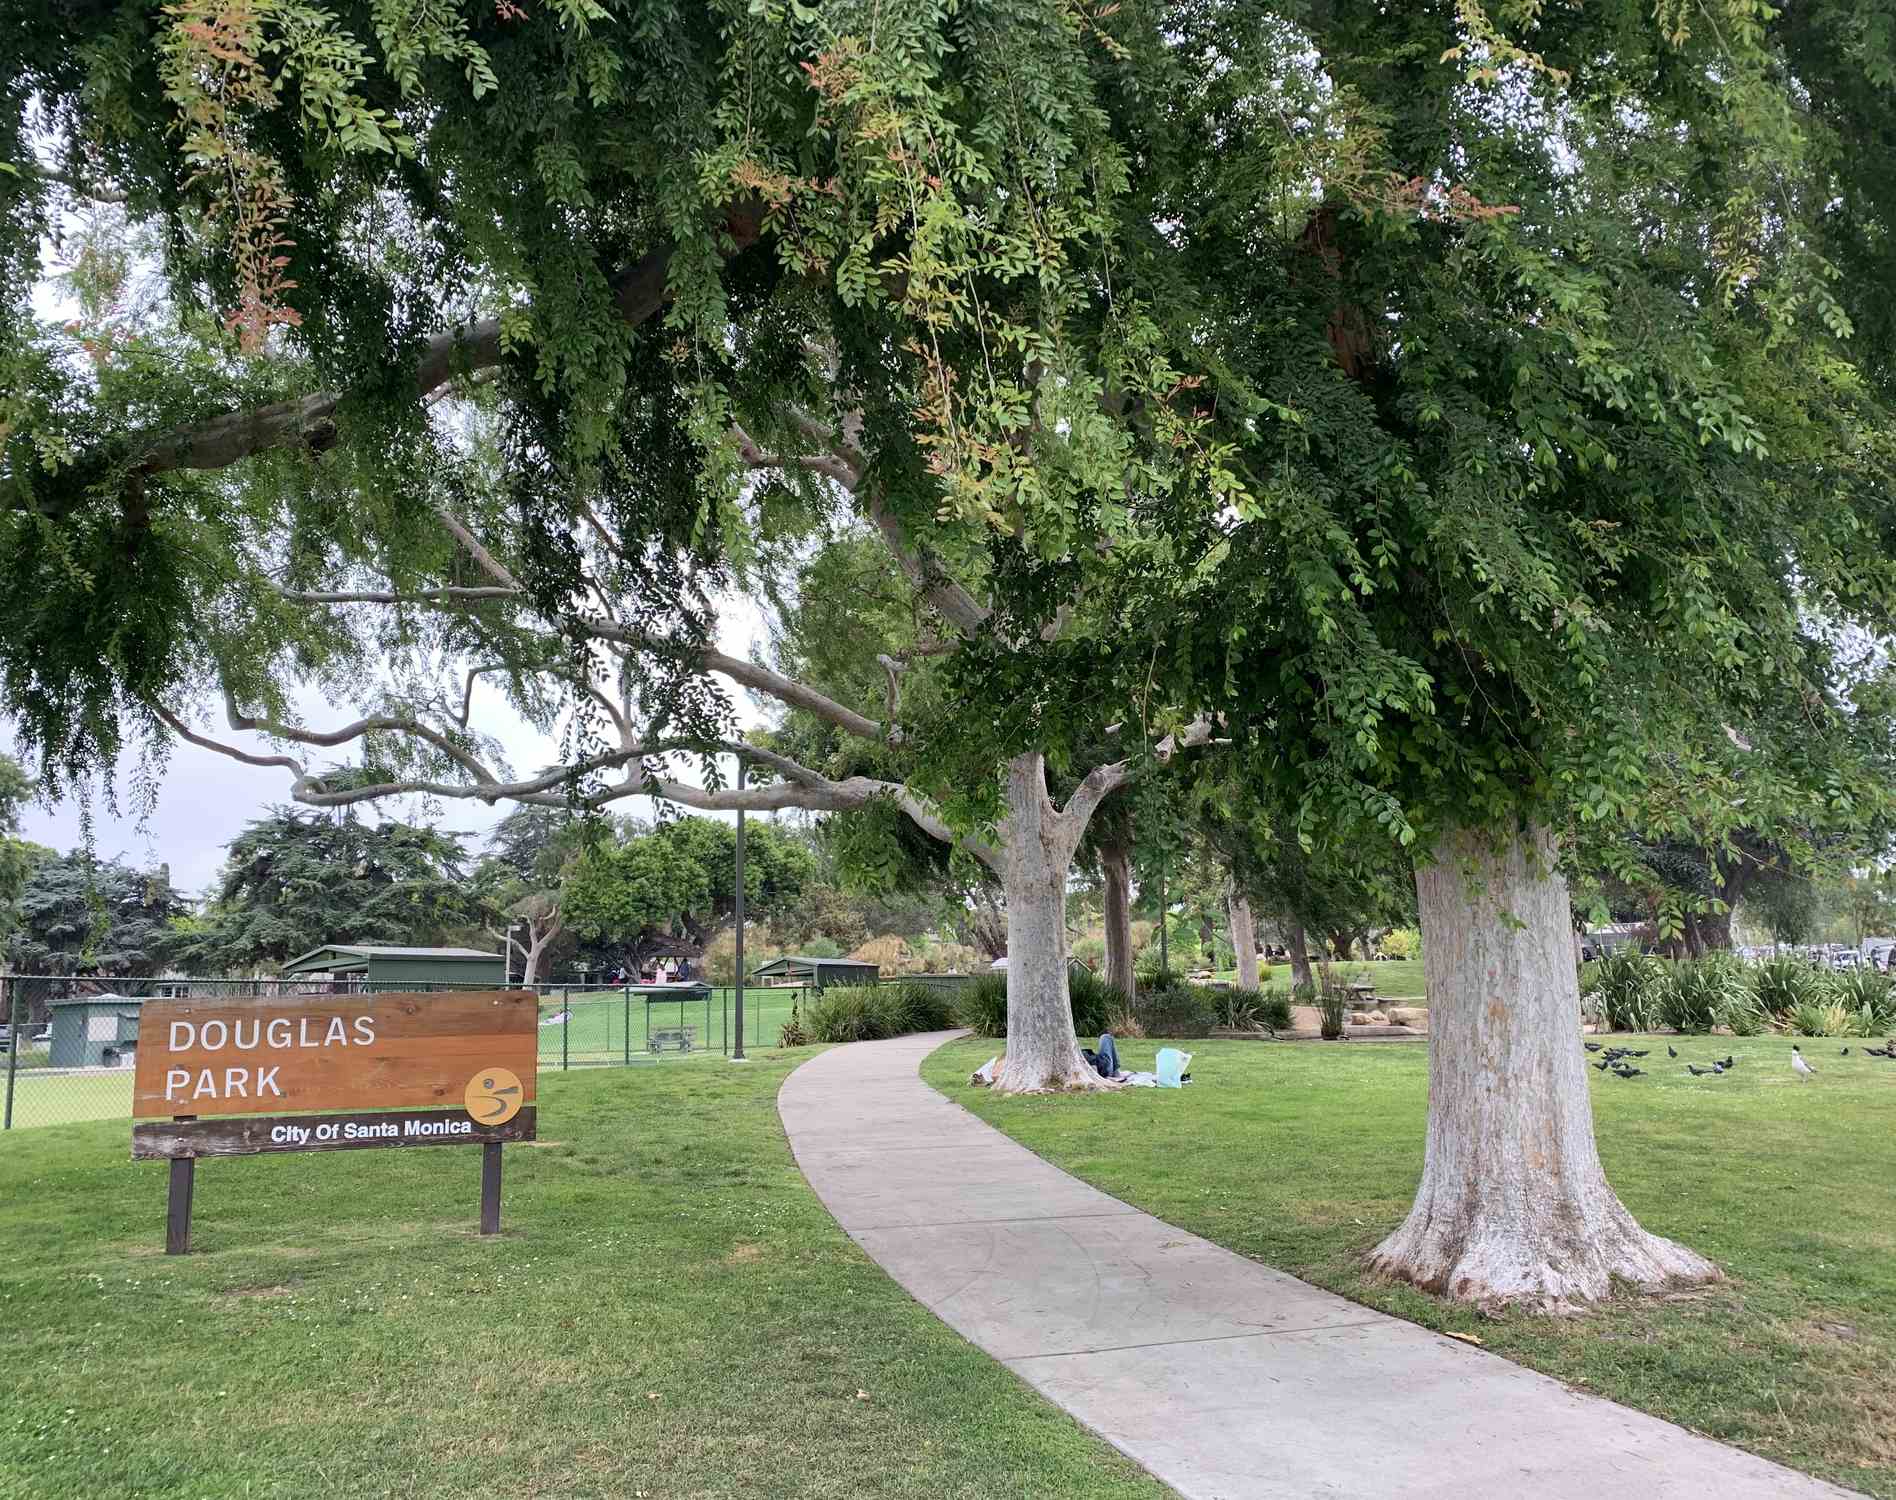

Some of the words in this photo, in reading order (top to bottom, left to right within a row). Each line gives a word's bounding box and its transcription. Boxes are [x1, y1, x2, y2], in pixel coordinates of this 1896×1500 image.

[168, 1016, 376, 1052] DOUGLAS
[165, 1066, 282, 1100] PARK
[271, 1125, 310, 1145] City
[315, 1124, 339, 1139] Of
[344, 1122, 399, 1138] Santa
[404, 1118, 472, 1136] Monica
